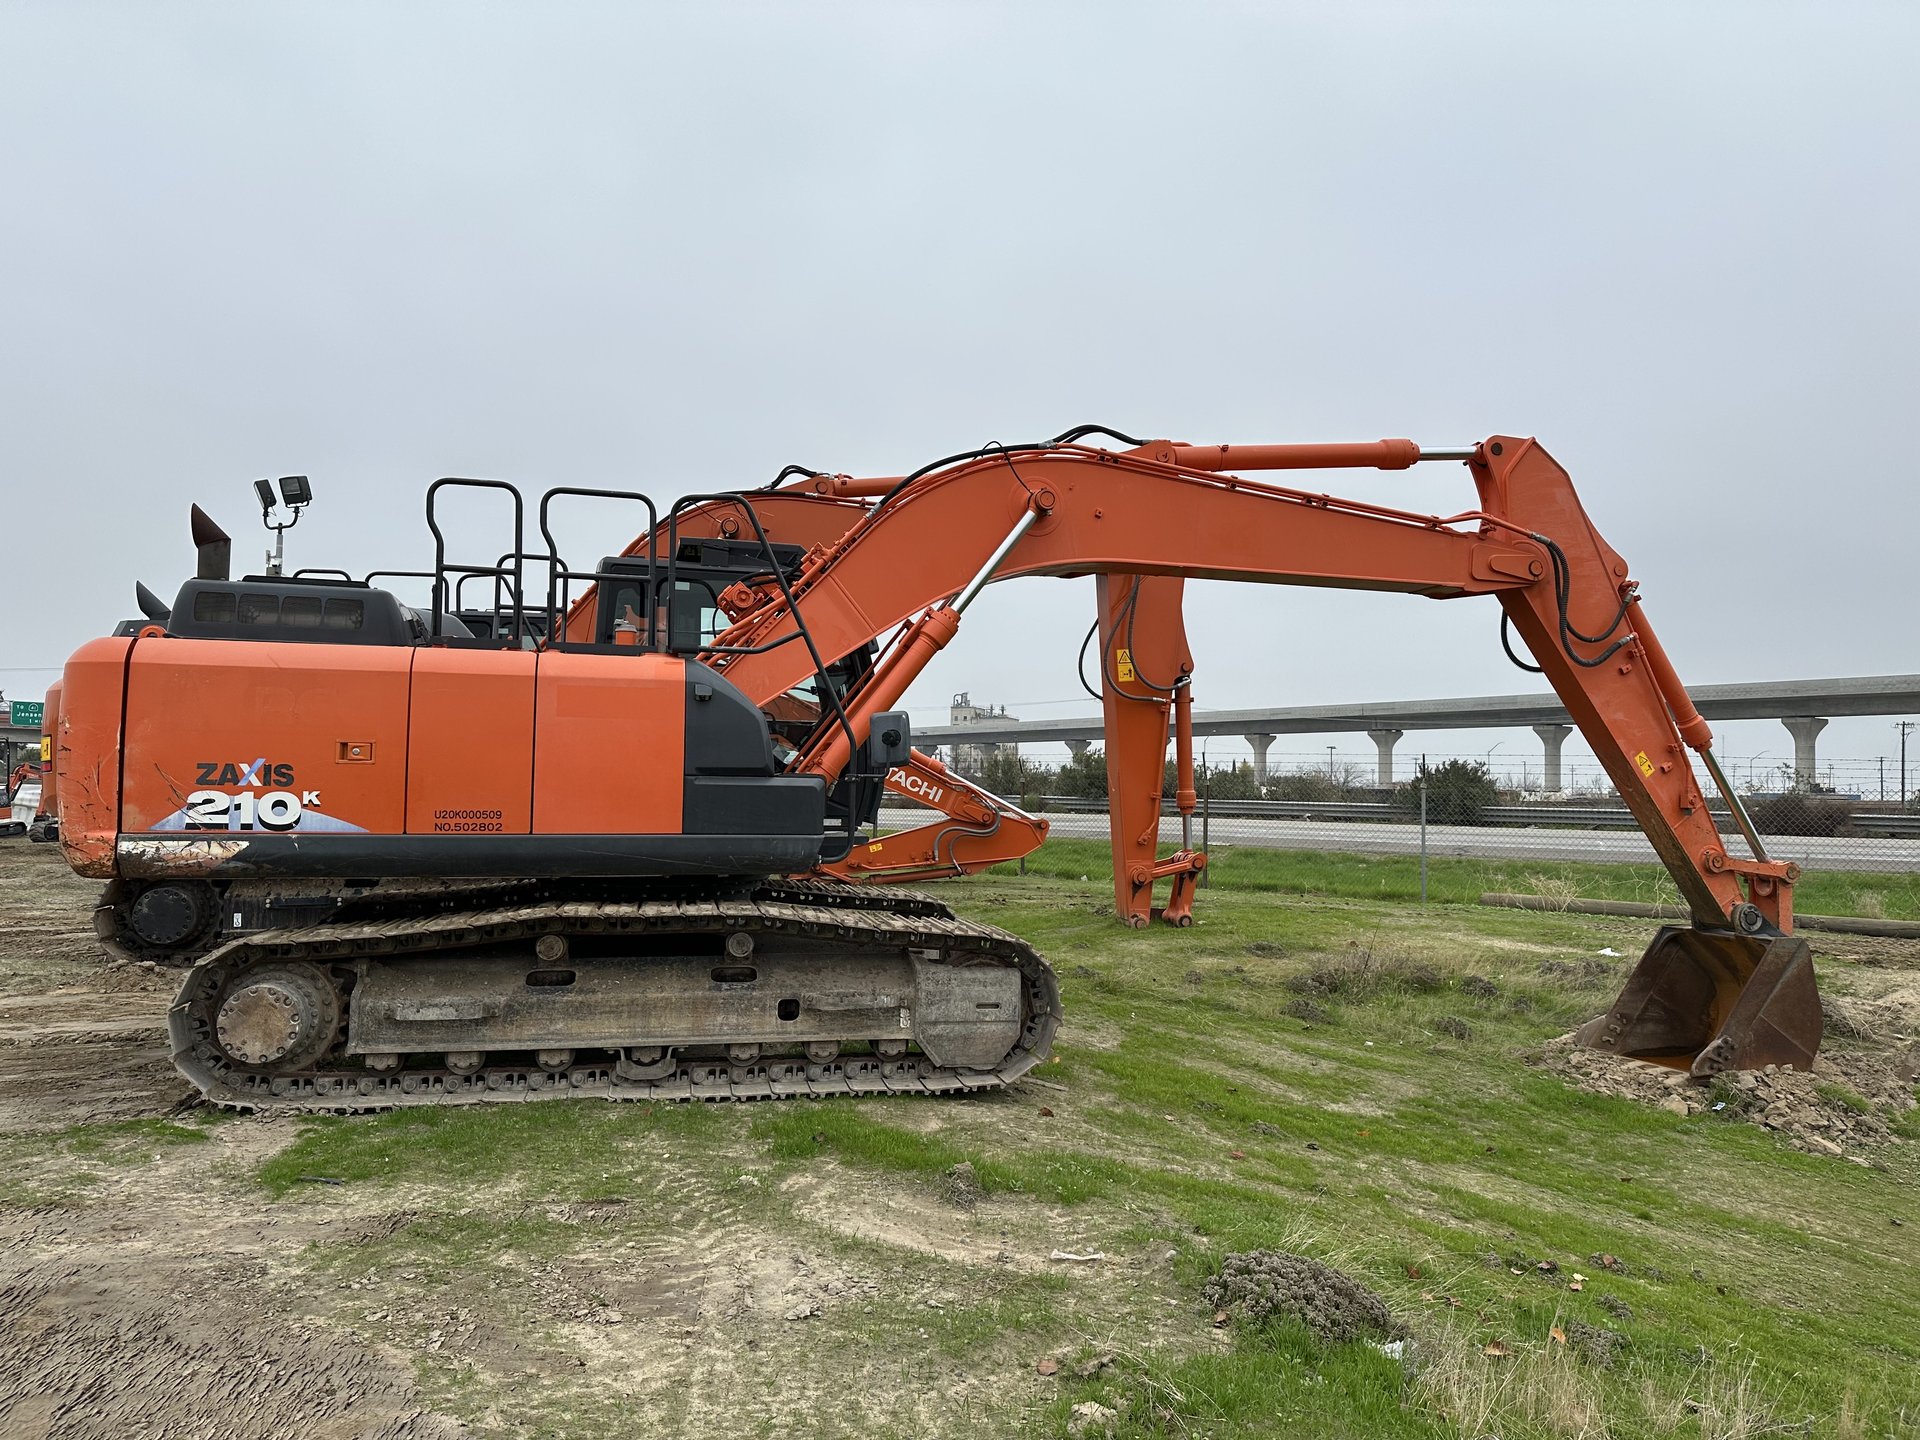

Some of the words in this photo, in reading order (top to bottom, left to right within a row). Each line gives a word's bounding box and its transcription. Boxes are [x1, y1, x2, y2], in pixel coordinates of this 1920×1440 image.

[195, 758, 295, 787] ZAXIS
[434, 810, 502, 819] U20K000509
[434, 823, 503, 831] NO.502802
